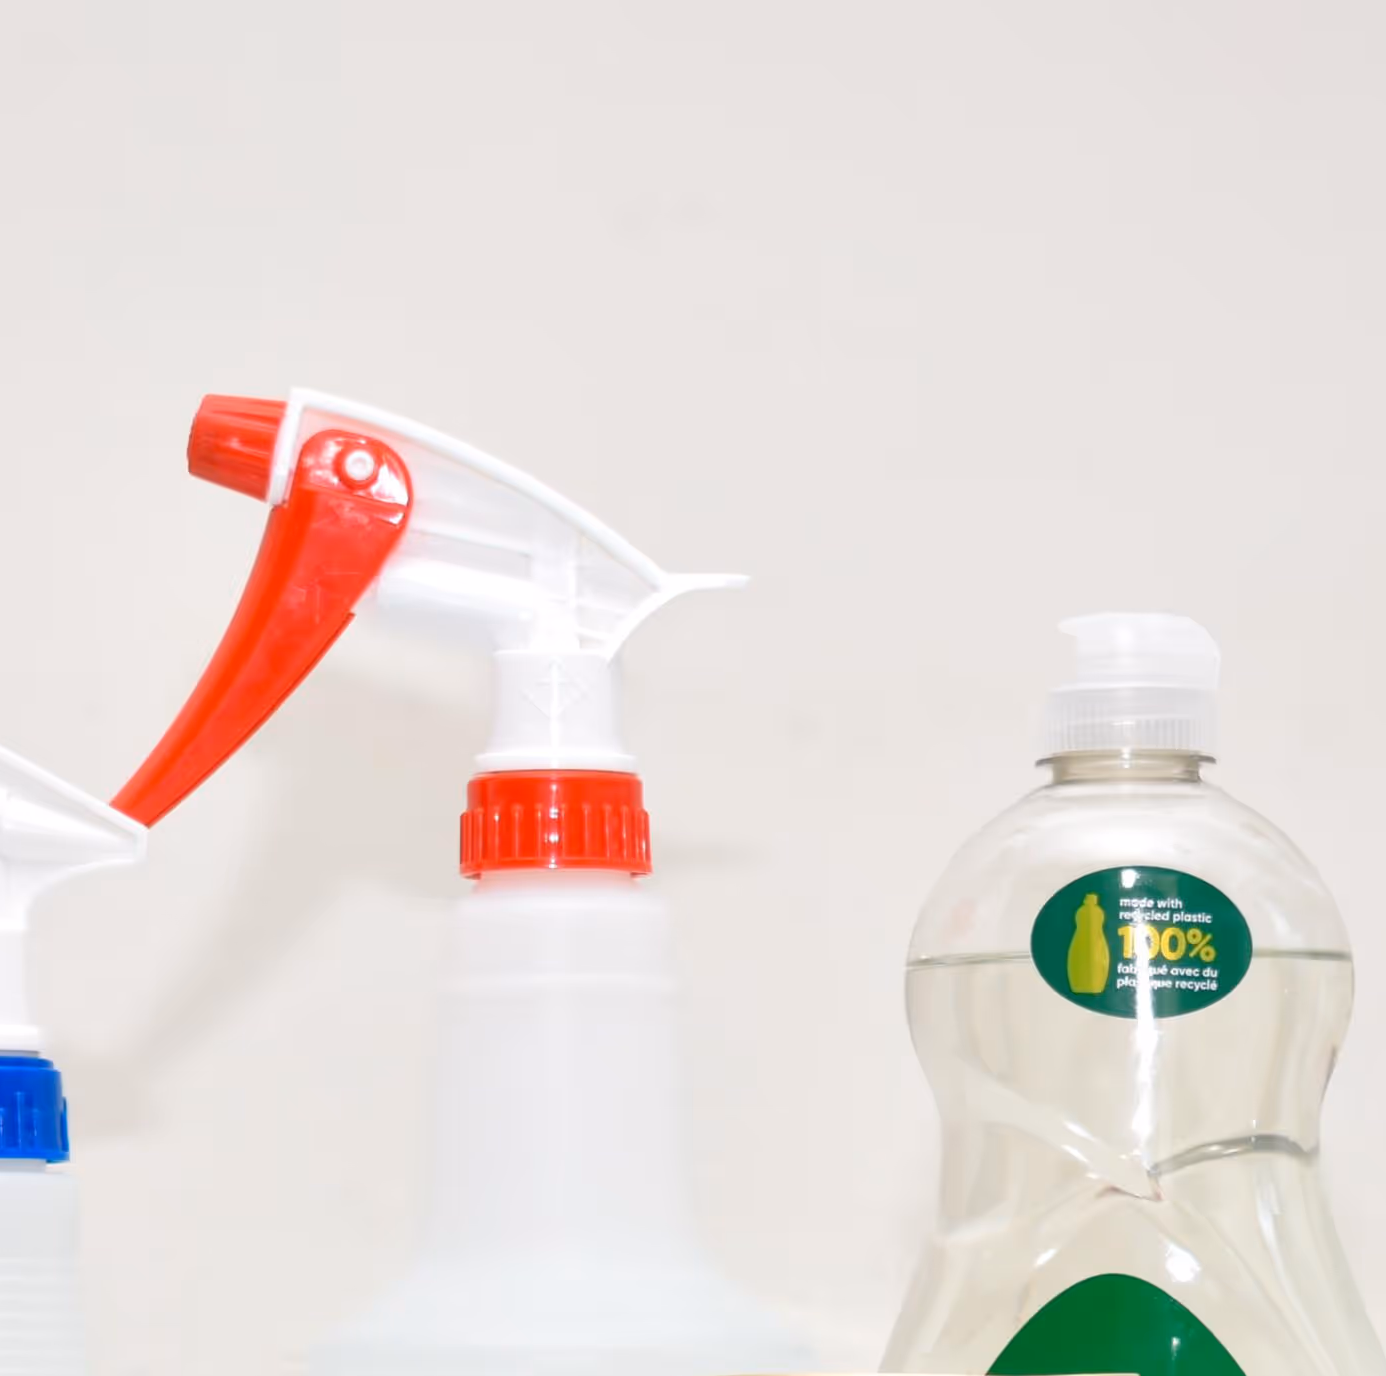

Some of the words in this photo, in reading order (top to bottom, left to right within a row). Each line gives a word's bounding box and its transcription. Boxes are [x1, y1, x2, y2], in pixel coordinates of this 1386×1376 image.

[1119, 898, 1154, 908] made
[1156, 898, 1183, 909] with
[1172, 911, 1212, 924] plastic
[1117, 923, 1216, 963] 100%
[1170, 968, 1200, 977] avec
[1202, 967, 1218, 977] du
[1175, 978, 1217, 992] recyclé
